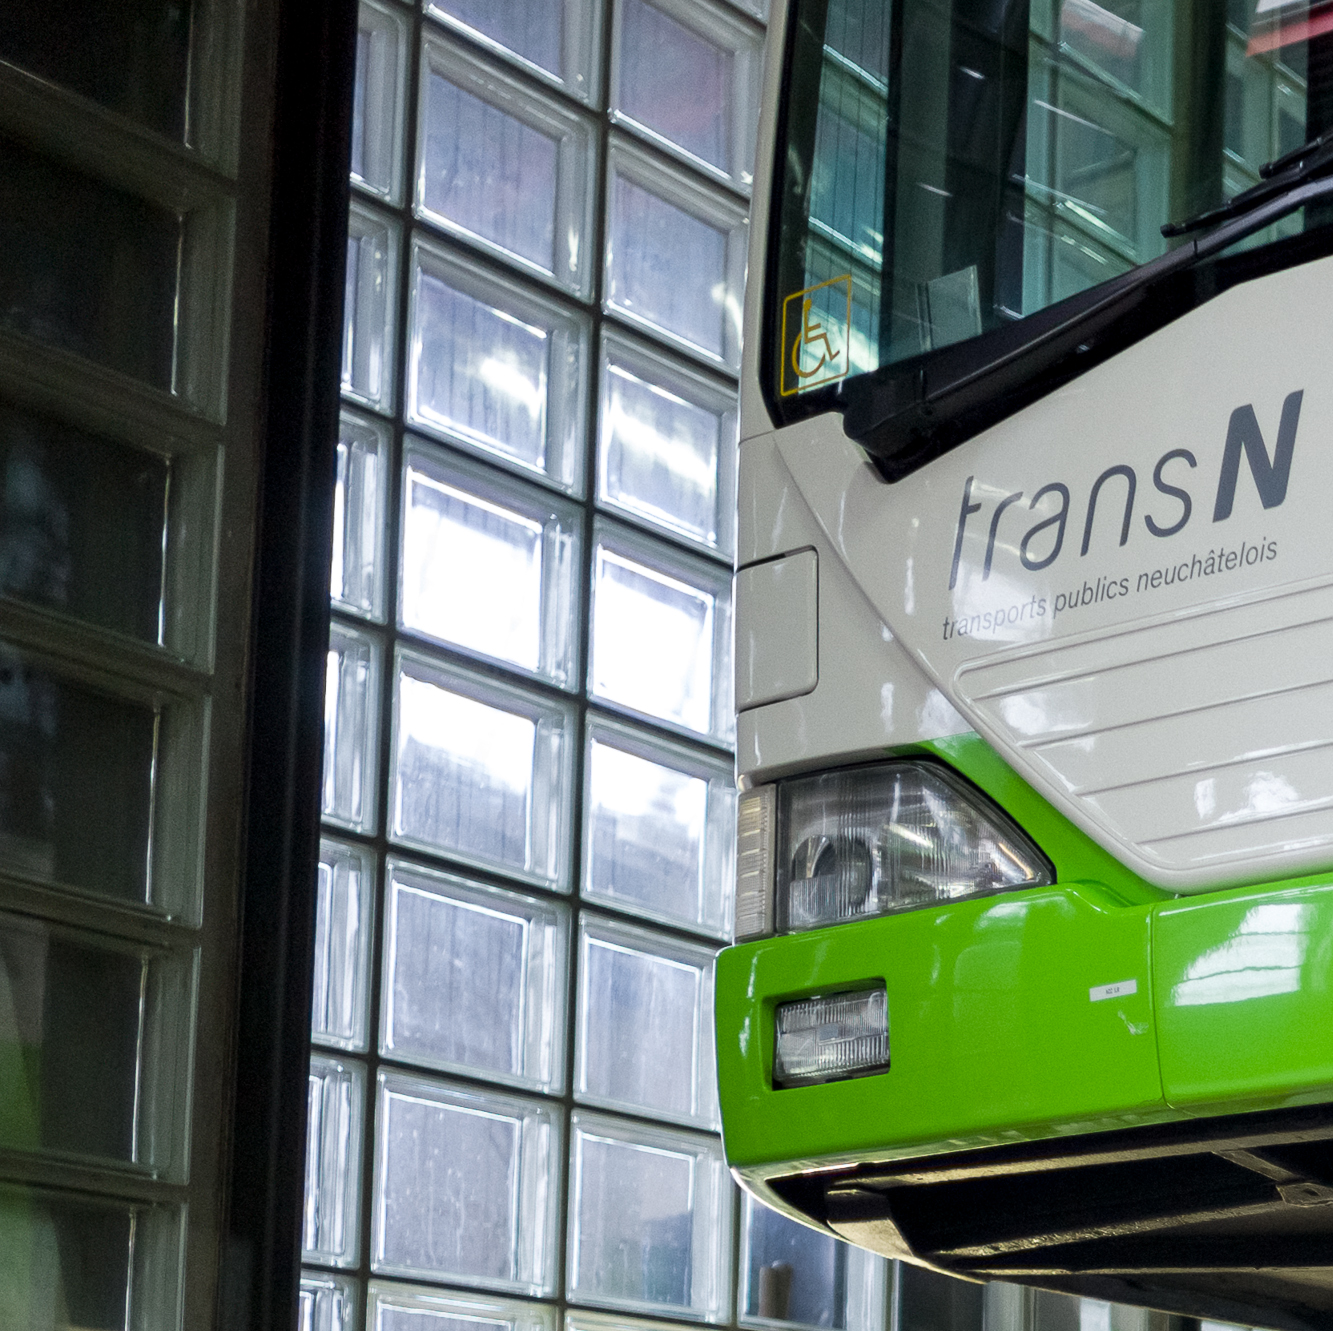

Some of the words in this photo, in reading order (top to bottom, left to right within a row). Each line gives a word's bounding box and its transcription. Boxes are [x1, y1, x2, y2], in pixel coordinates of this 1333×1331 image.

[942, 594, 1047, 640] transports
[1053, 575, 1130, 619] publics
[1136, 536, 1278, 593] neuchâtelois
